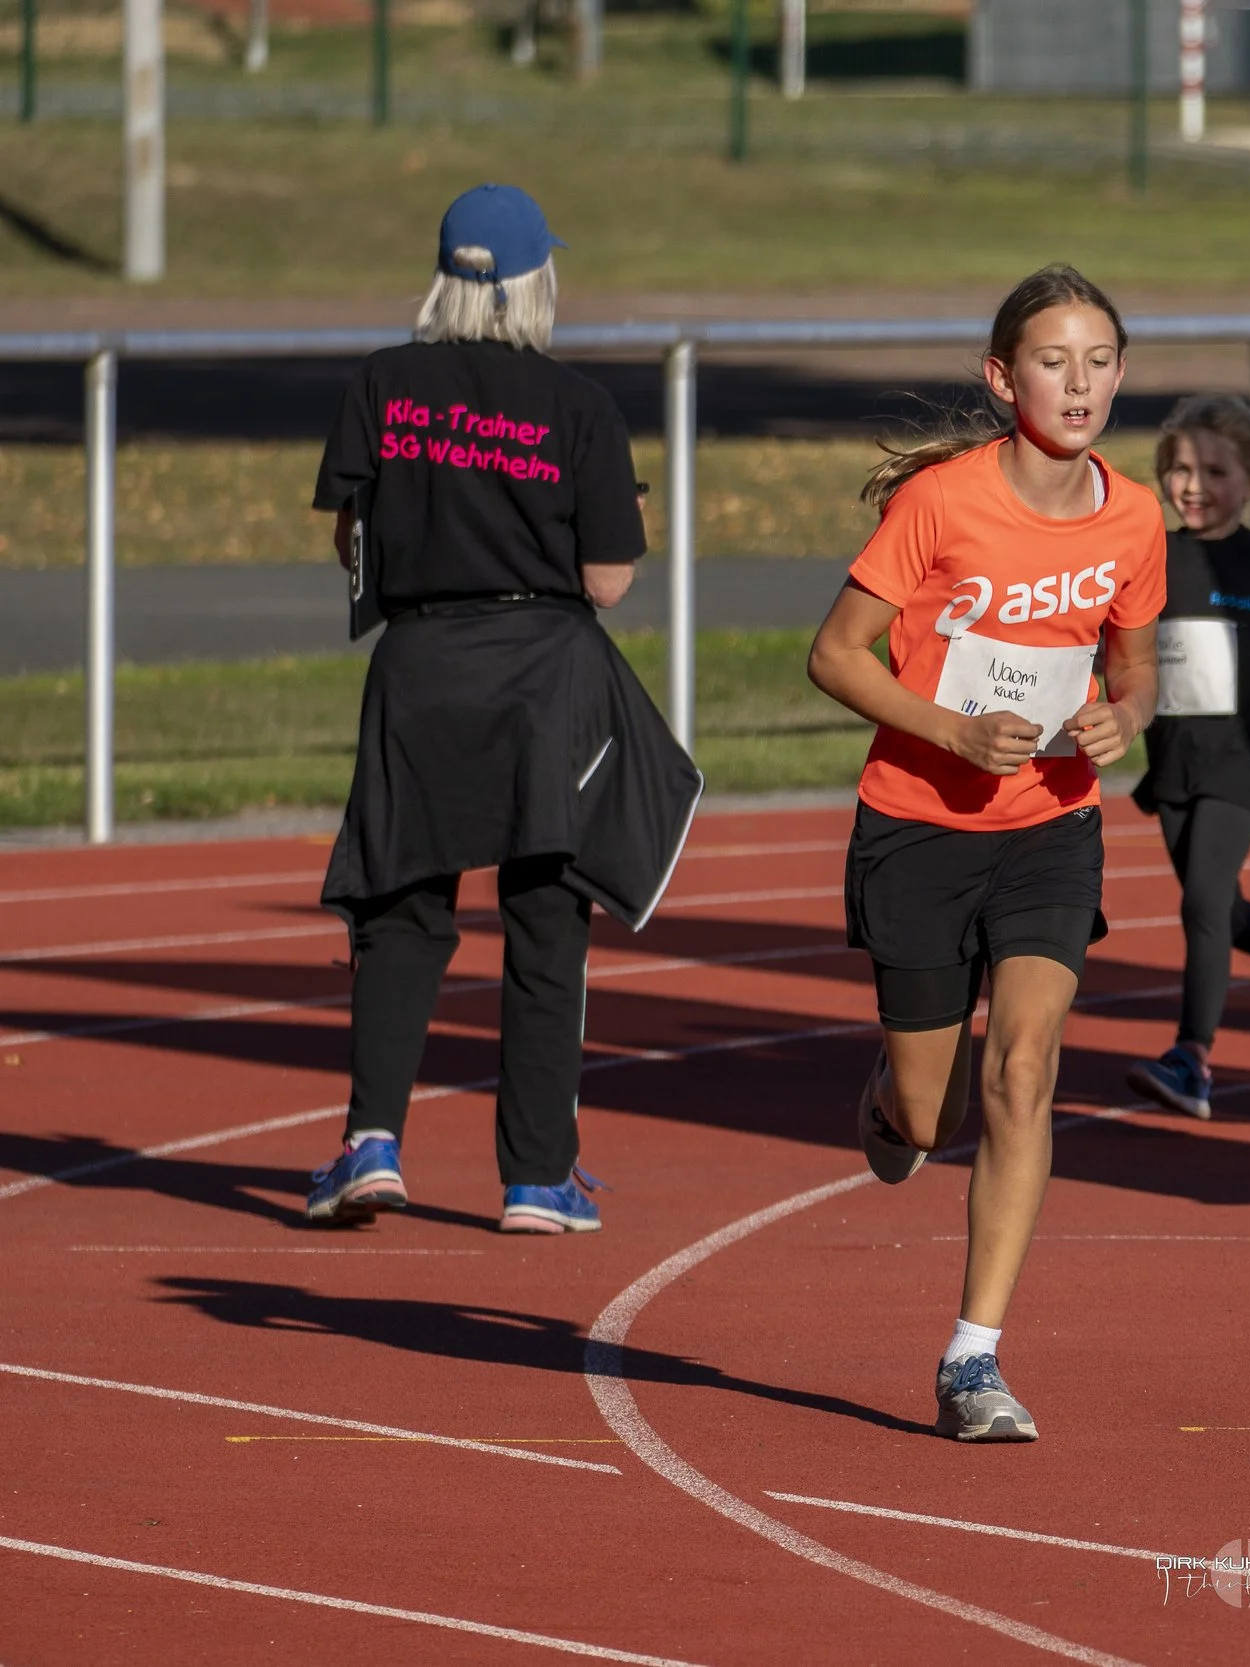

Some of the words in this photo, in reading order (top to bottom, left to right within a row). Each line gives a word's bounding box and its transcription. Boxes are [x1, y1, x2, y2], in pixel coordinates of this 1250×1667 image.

[448, 403, 550, 446] Trainer
[380, 432, 421, 460] SG
[427, 437, 561, 483] Wehrheim
[987, 657, 1037, 687] Naomi
